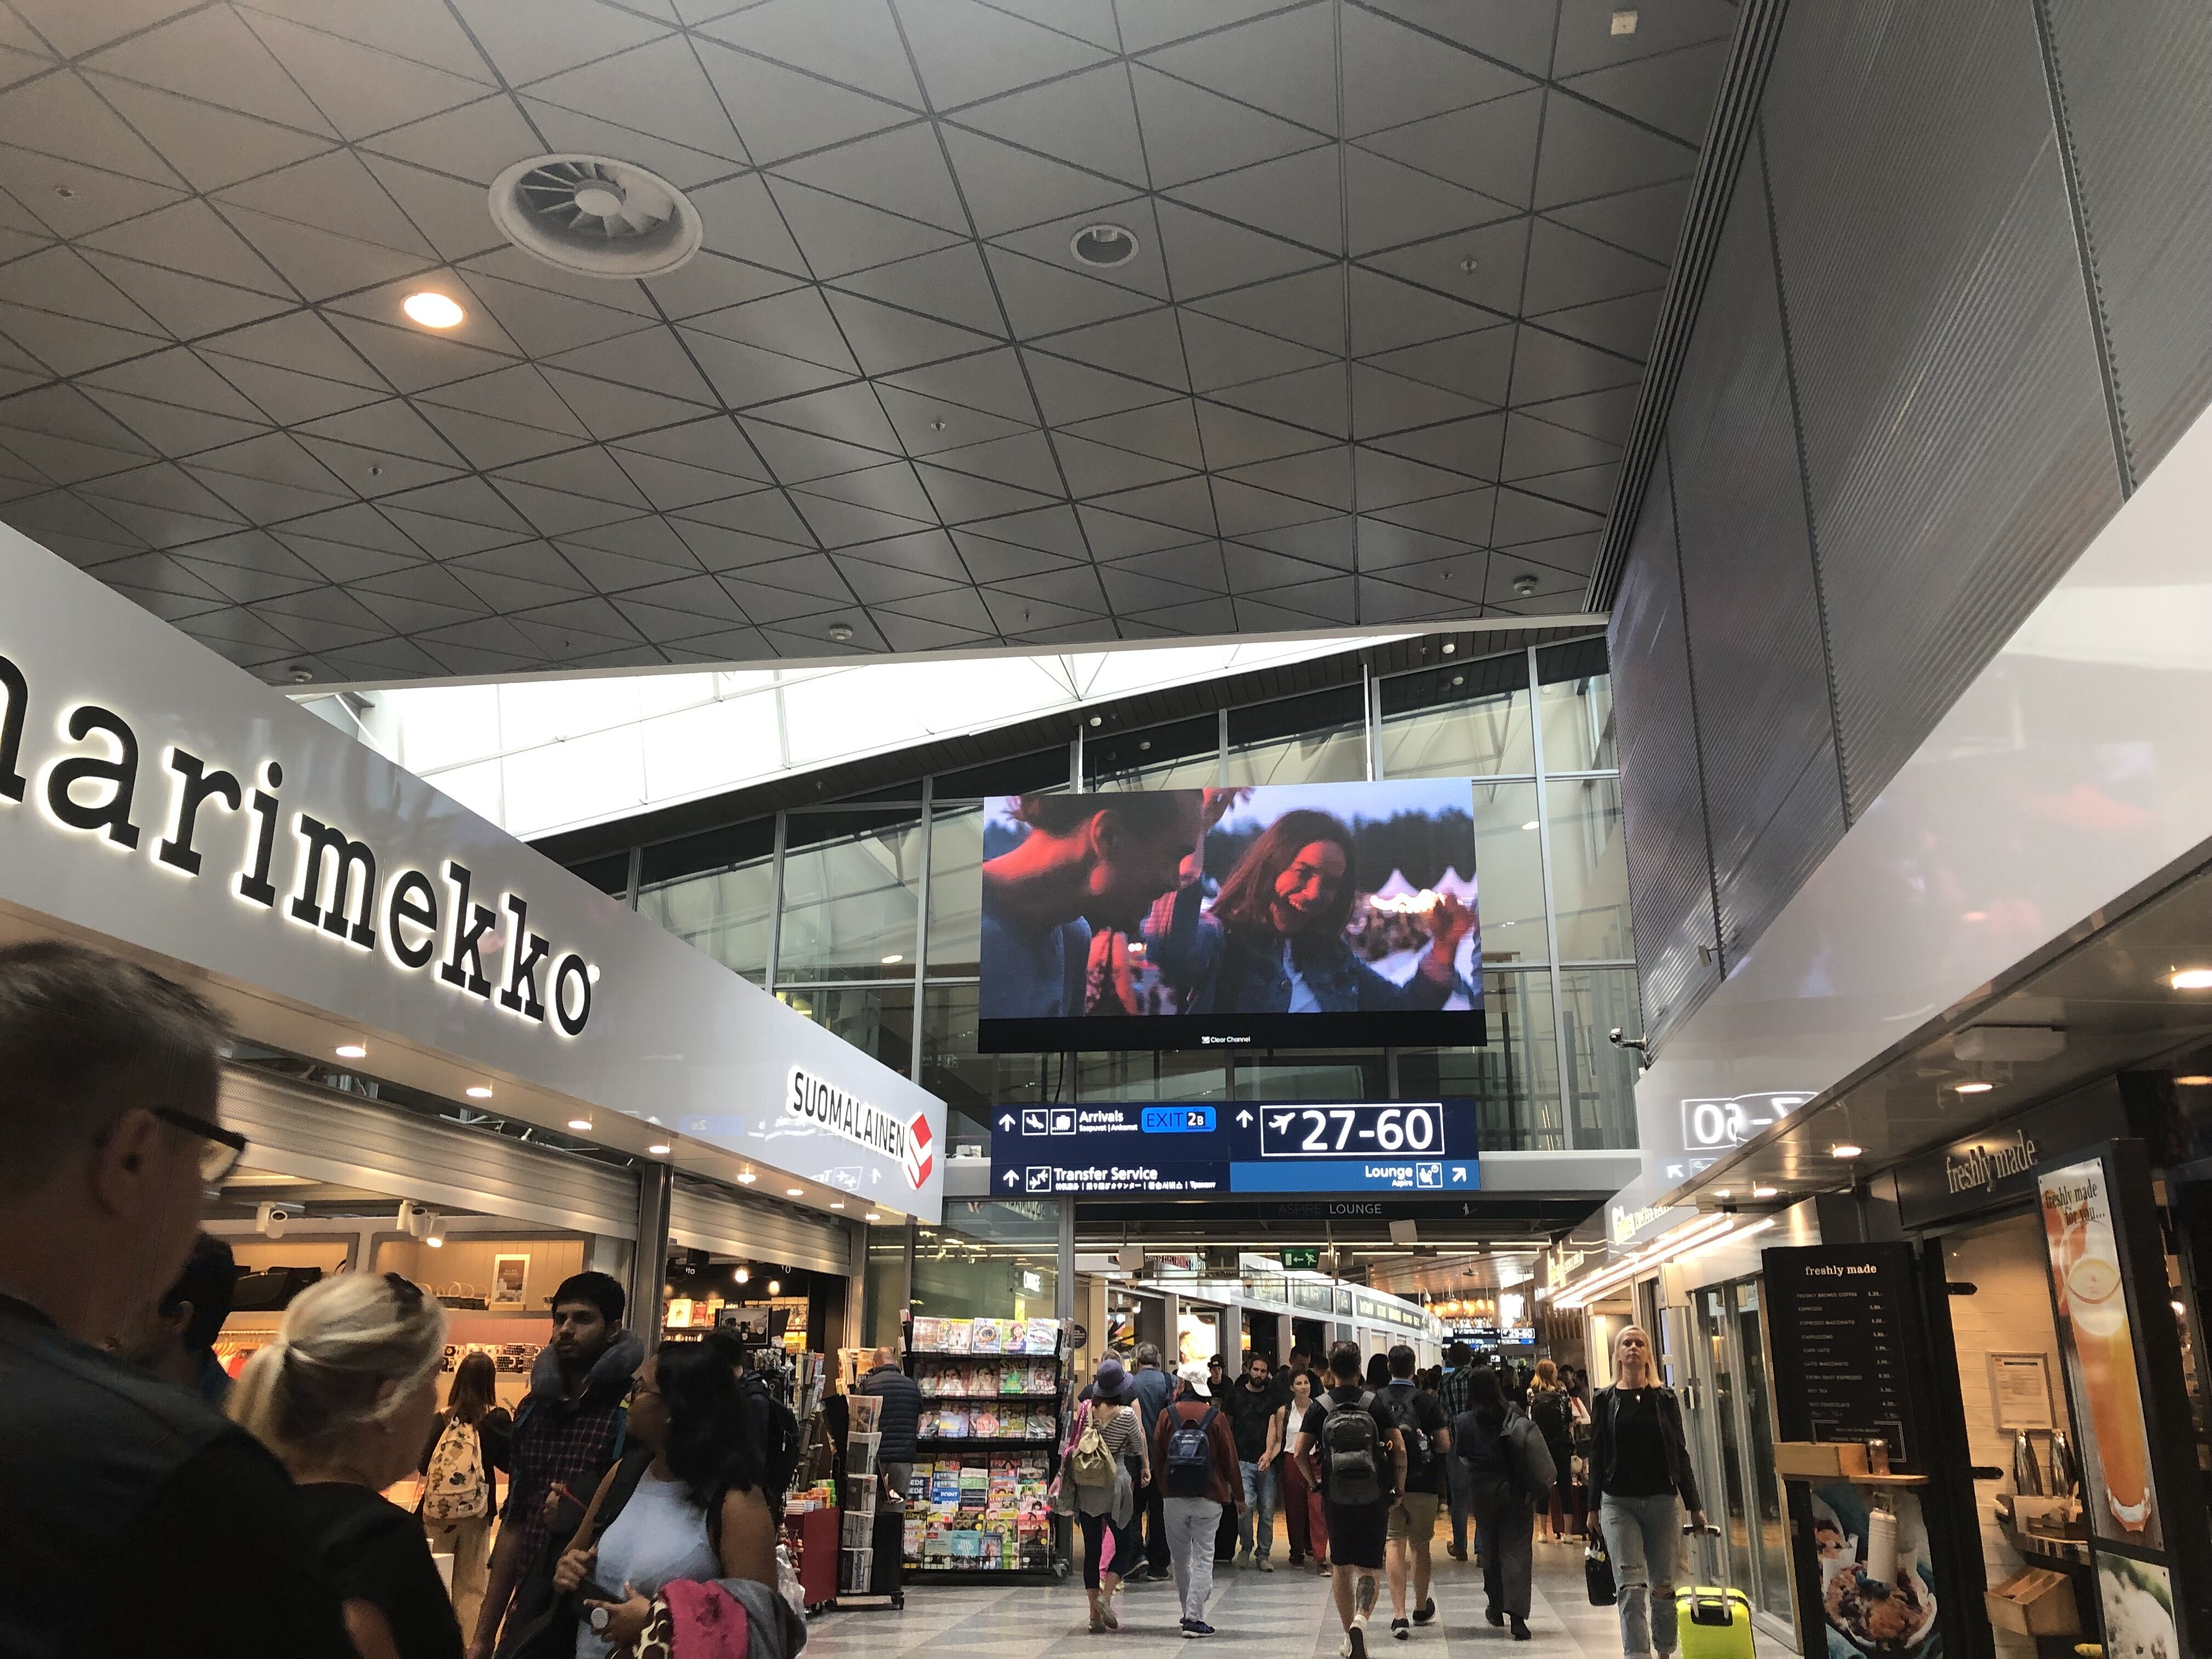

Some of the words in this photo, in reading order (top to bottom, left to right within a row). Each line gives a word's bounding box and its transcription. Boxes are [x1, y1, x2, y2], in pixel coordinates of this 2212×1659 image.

[793, 1071, 905, 1159] SUOMALAINEN
[1079, 1110, 1124, 1122] Arrivals
[1147, 1112, 1183, 1127] EXIT
[1302, 1109, 1433, 1150] 27-60
[1946, 1146, 1991, 1193] freshly
[1995, 1129, 2037, 1179] made
[1054, 1167, 1108, 1181] Transfer
[1111, 1167, 1158, 1180] Service
[1365, 1165, 1413, 1179] Lounge
[2045, 1186, 2073, 1209] freshly
[2074, 1178, 2098, 1202] made
[1278, 1204, 1321, 1214] ASPIRE
[1329, 1203, 1382, 1214] LOUNGE
[2064, 1206, 2079, 1226] for
[1805, 1265, 1843, 1277] freshly
[1847, 1264, 1877, 1274] made
